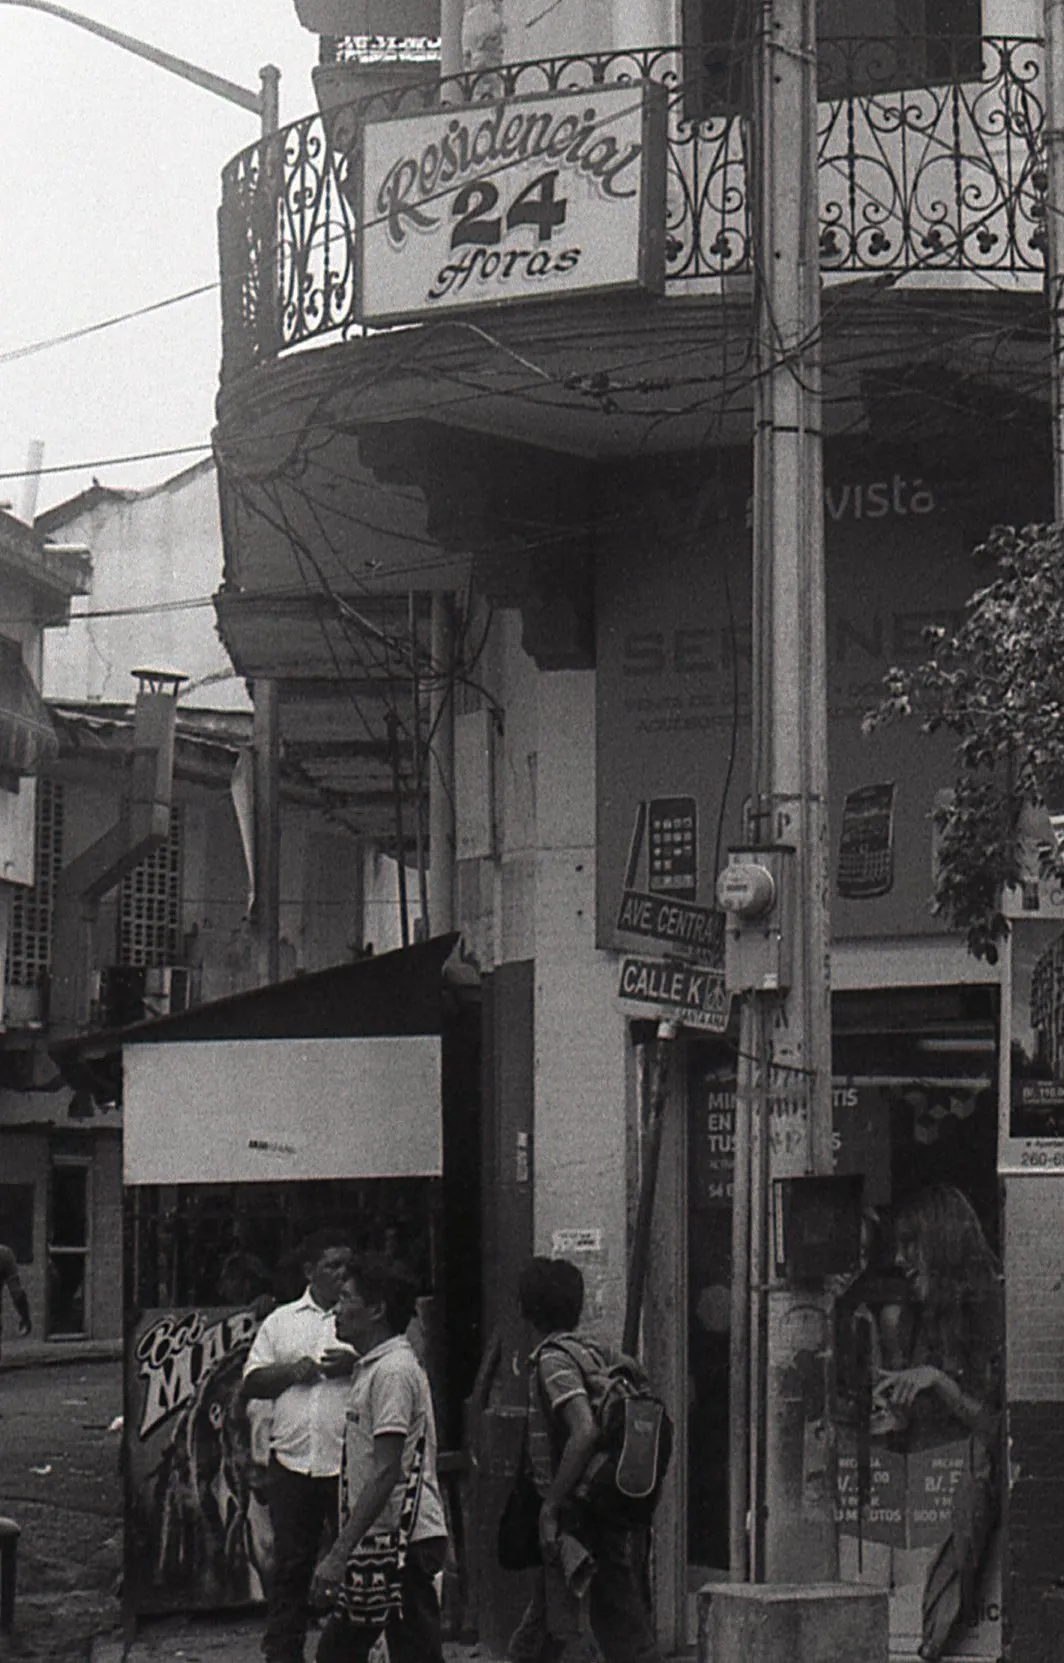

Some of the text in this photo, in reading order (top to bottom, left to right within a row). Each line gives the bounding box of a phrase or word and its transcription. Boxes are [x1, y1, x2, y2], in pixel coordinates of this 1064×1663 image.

[378, 105, 642, 242] Residencial
[451, 170, 567, 250] 24
[428, 247, 582, 299] Horas
[621, 899, 653, 929] AVE
[624, 966, 705, 1005] CALLE K
[708, 1113, 732, 1131] EN
